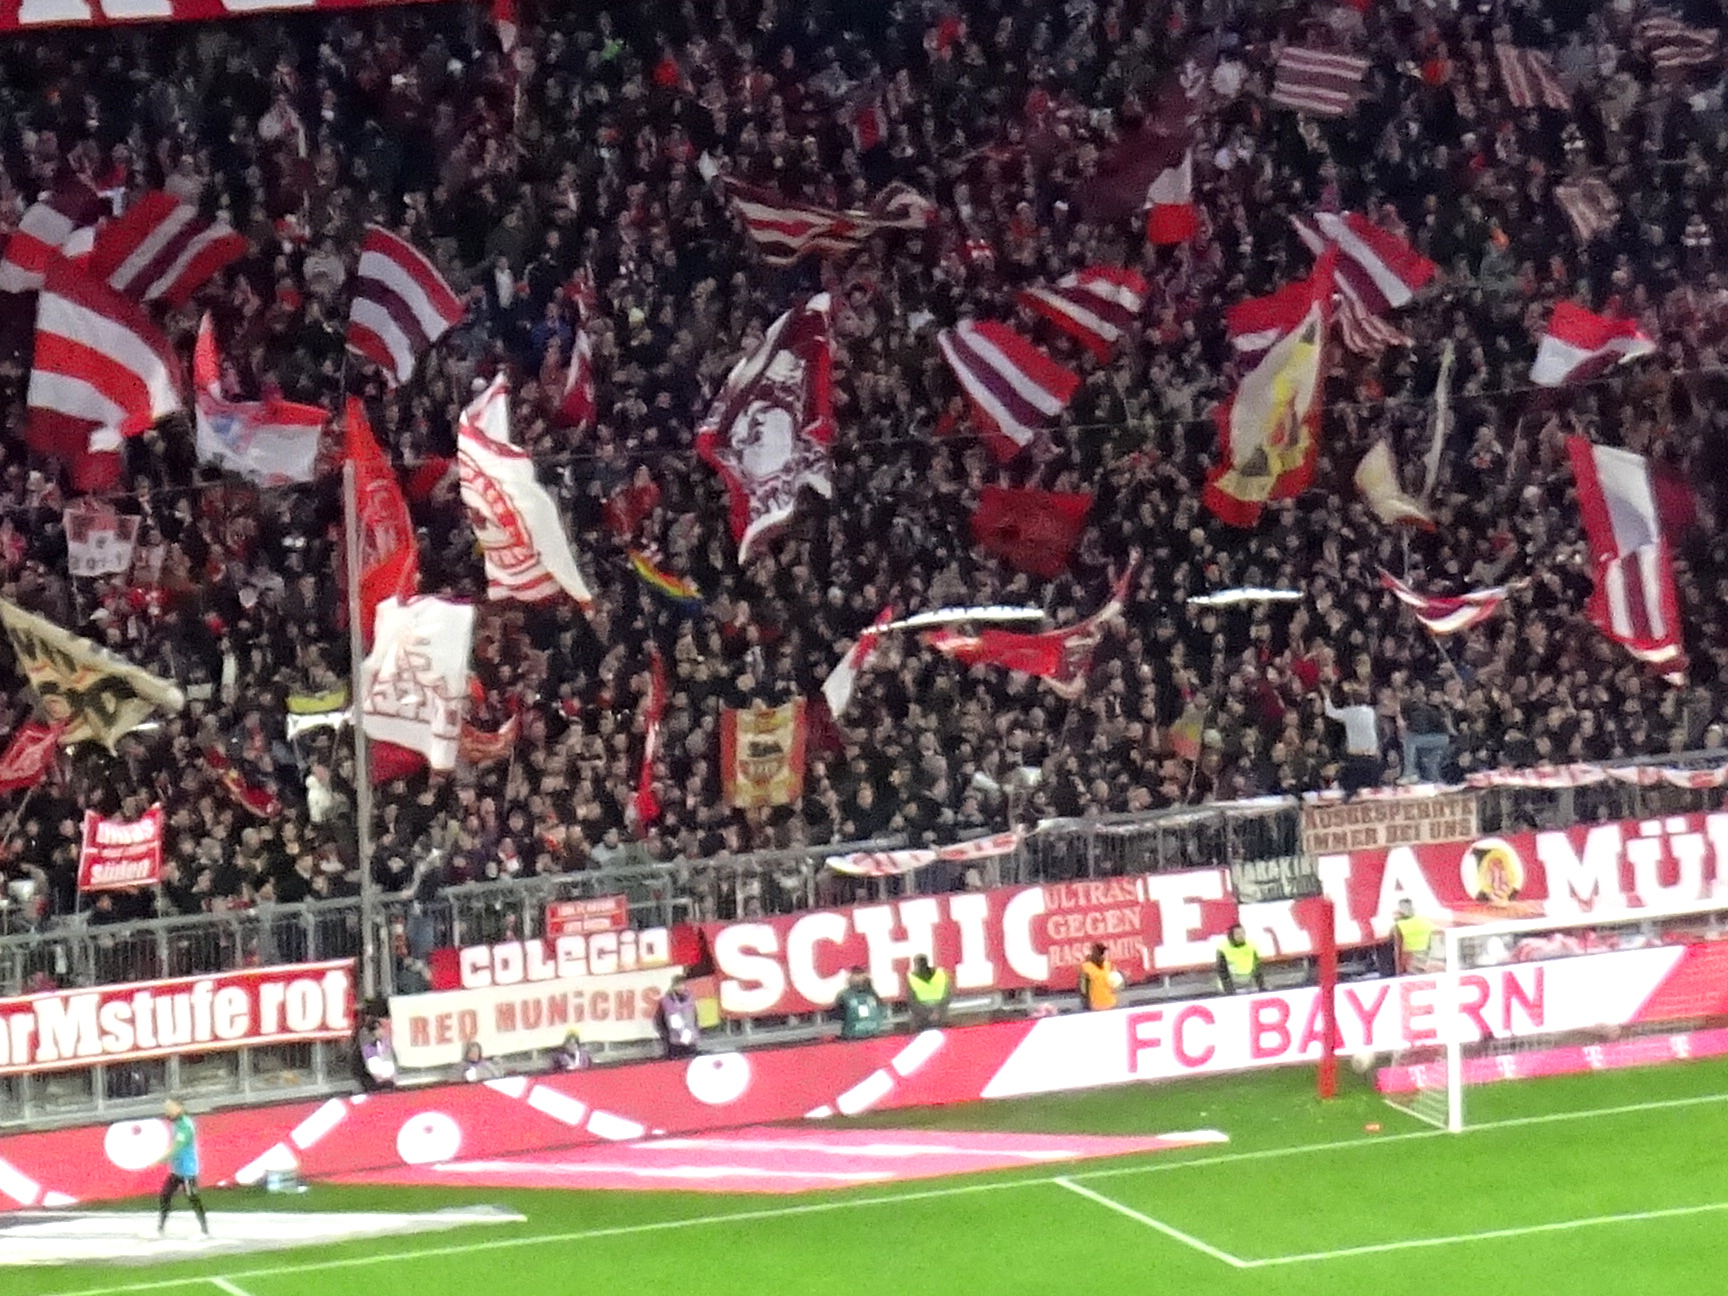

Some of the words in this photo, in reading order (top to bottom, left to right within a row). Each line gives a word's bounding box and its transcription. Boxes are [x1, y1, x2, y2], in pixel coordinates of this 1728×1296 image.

[1306, 827, 1379, 850] IMMER
[1428, 817, 1472, 839] UNS
[1045, 878, 1136, 910] ULTRAS
[713, 845, 1453, 1013] SCHICERIA
[1046, 906, 1142, 939] GEGEN
[1047, 936, 1144, 967] RASSMUS
[258, 970, 350, 1035] rot
[1126, 1003, 1216, 1074] FC
[1248, 966, 1545, 1060] BAYERN
[409, 1008, 479, 1048] RED
